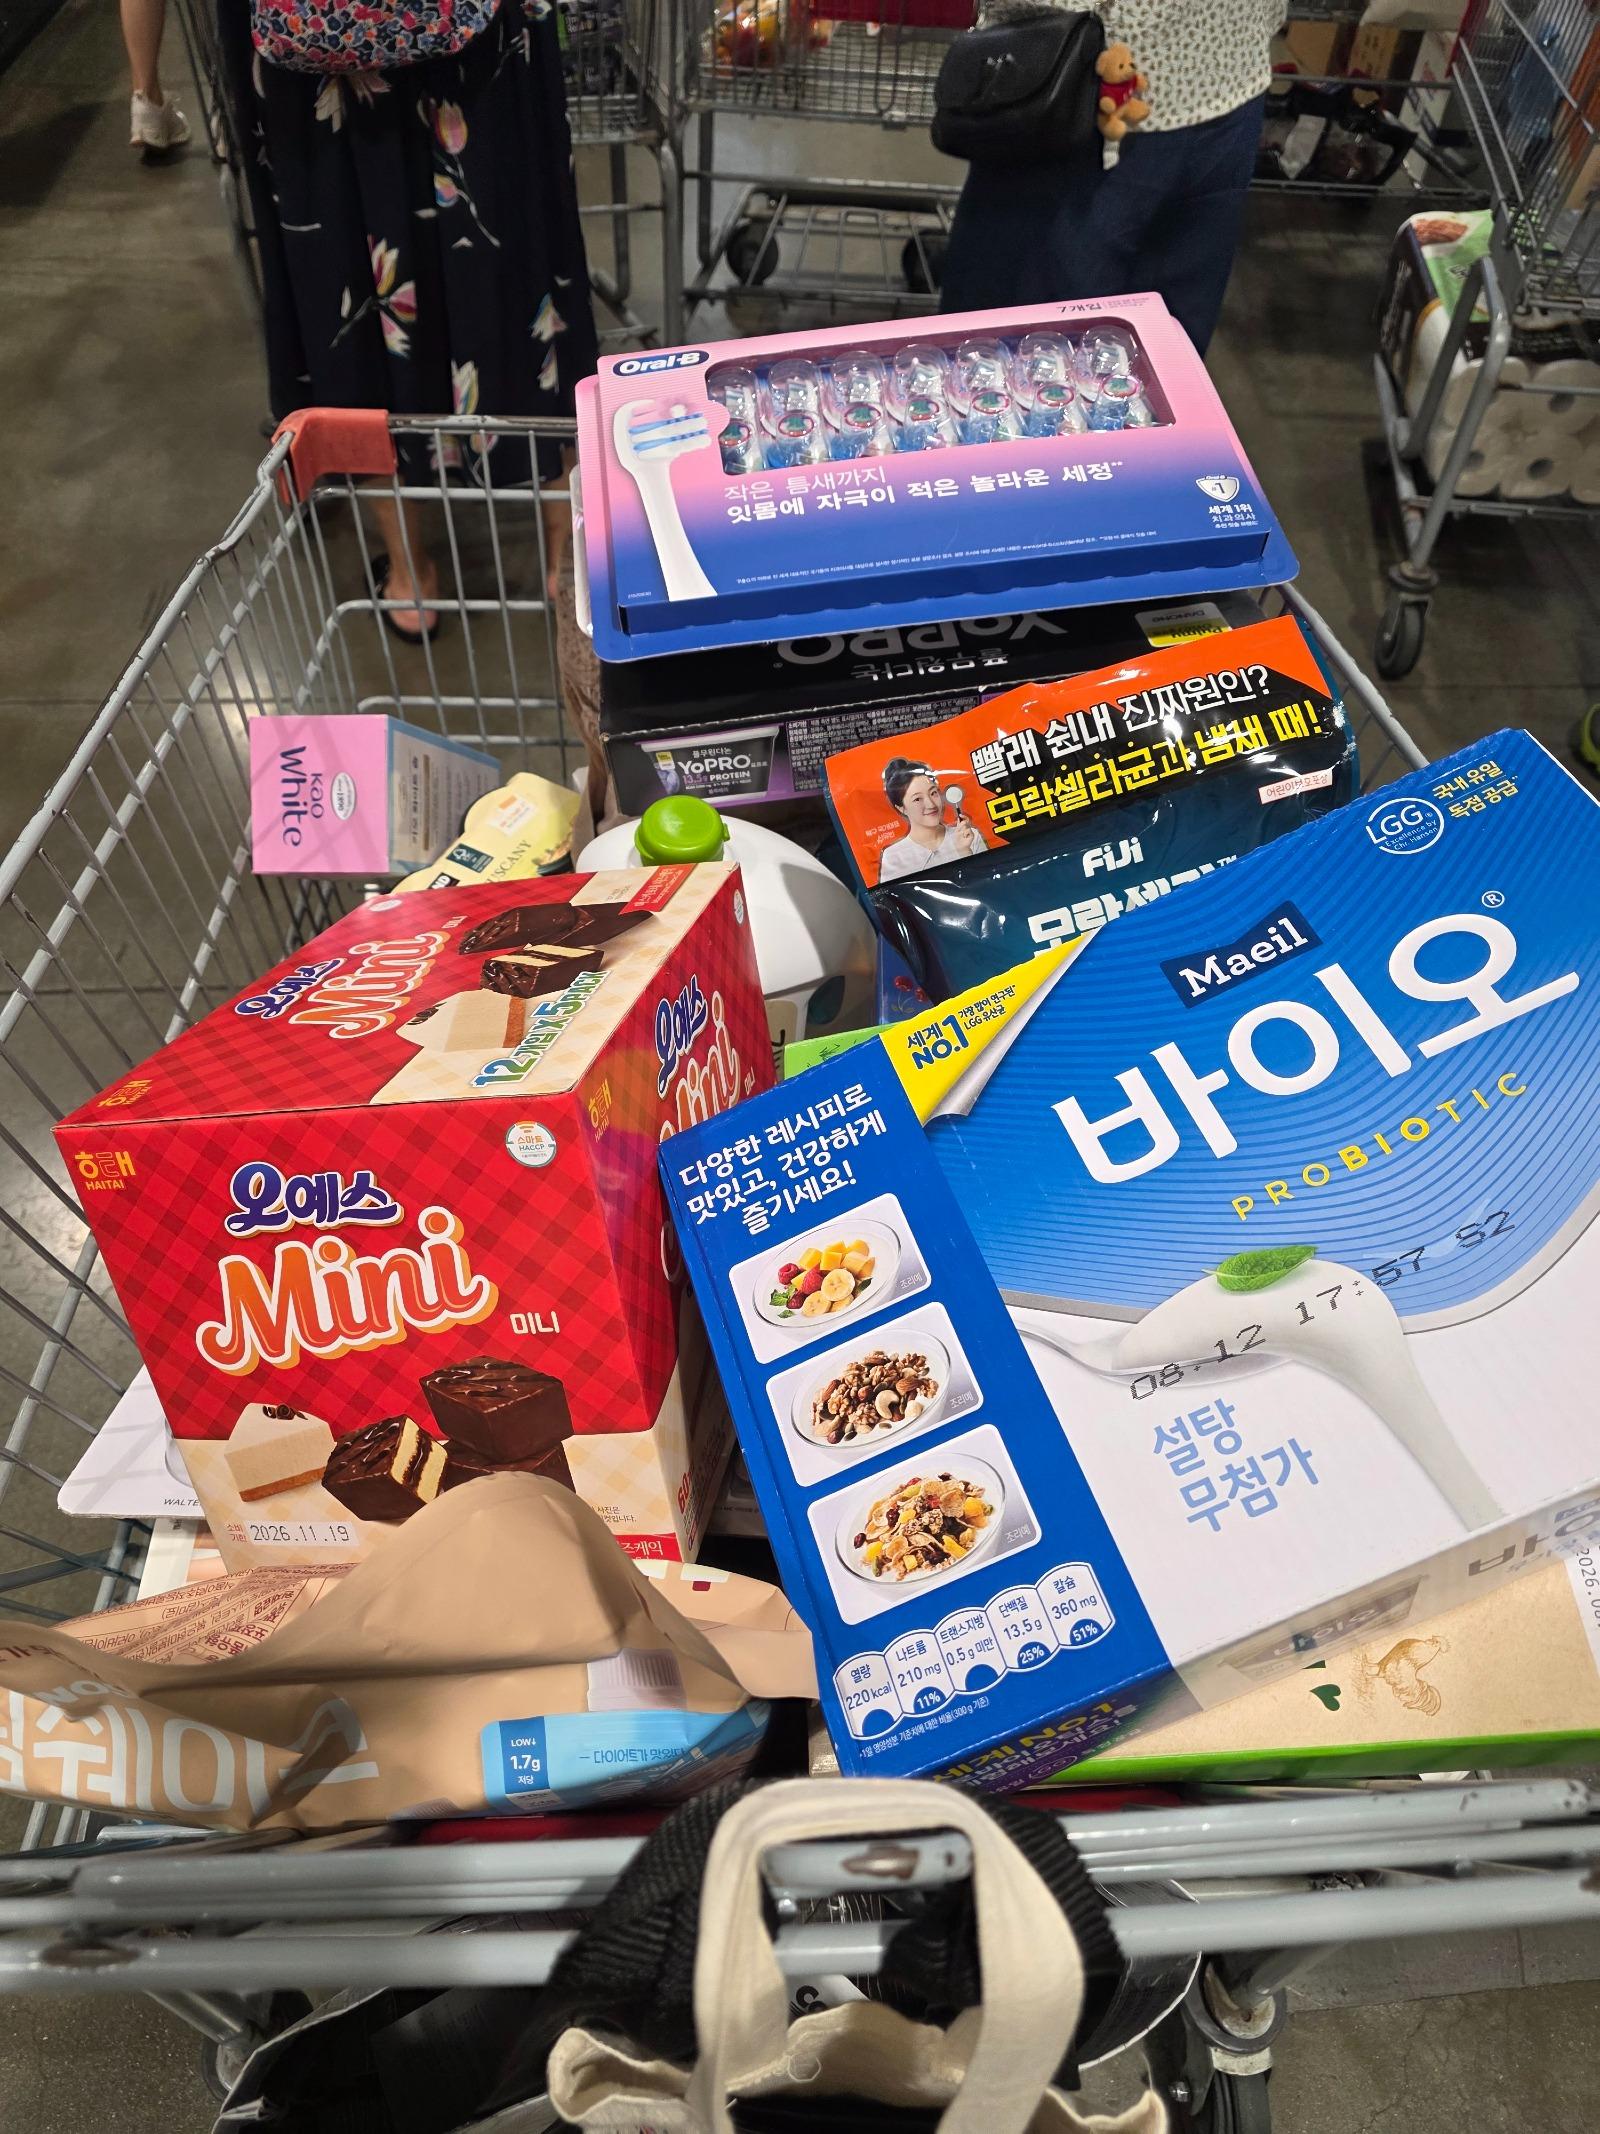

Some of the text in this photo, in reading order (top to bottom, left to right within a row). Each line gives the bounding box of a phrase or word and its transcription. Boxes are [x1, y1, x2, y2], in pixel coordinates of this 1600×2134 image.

[618, 352, 701, 375] Oral-B
[724, 466, 887, 503] 작은 틈새까지
[726, 498, 805, 524] 잇몸에
[817, 485, 896, 511] 자극이
[906, 477, 960, 500] 적은
[970, 468, 1050, 494] 놀라운
[971, 728, 1042, 785] 빨래
[1045, 702, 1117, 759] 쉰내
[677, 754, 751, 775] YoPRO
[709, 771, 751, 782] PROTEIN
[986, 699, 1323, 834] 모락셀라균과 냄새 때!
[1432, 760, 1504, 800] 국내 유일
[280, 746, 308, 848] White
[1448, 794, 1487, 819] 독점
[1366, 804, 1424, 845] LGG
[1384, 819, 1437, 848] Excellence by
[1409, 827, 1439, 846] Hansen
[1177, 915, 1309, 999] Maeil
[235, 957, 347, 1020] 오예스
[287, 931, 452, 1040] Mini
[958, 1005, 975, 1018] 가장
[974, 997, 992, 1014] 많이
[963, 1005, 1007, 1031] LGG 유산균
[655, 974, 709, 1100] 오예스
[907, 1021, 943, 1049] 세계
[1050, 911, 1580, 1185] 바이오
[678, 1082, 873, 1187] 다양한 레시피로
[1230, 1071, 1528, 1223] PROBIOTIC
[686, 1109, 887, 1226] 맛있고, 건강하게
[85, 1180, 125, 1191] HAITAI
[741, 1158, 857, 1236] 즐기세요!
[224, 1161, 403, 1238] 오예스
[195, 1205, 499, 1376] Mini
[900, 1273, 923, 1289] 조리예
[511, 1311, 560, 1336] 미니
[1129, 1322, 1266, 1402] 08.12
[1294, 1246, 1426, 1326] 17:57
[950, 1390, 974, 1409] 조리예
[1152, 1397, 1244, 1478] 설탕
[1178, 1437, 1319, 1533] 무첨가
[226, 1523, 244, 1533] 소비
[230, 1533, 247, 1543] 기한
[250, 1524, 350, 1543] 2026.11.19
[1053, 1574, 1077, 1594] 칼슘
[998, 1595, 1029, 1618] 단백질
[1051, 1594, 1098, 1620] 360 mg
[939, 1614, 985, 1645] 트랜스지방
[1002, 1618, 1034, 1641] 13.5
[1072, 1622, 1098, 1642] 51%
[895, 1639, 928, 1663] 나트륨
[946, 1648, 967, 1667] 0.5
[974, 1636, 996, 1654] 미만
[1019, 1645, 1045, 1664] 25%
[850, 1663, 871, 1683] 열량
[897, 1661, 942, 1688] 210 mg
[844, 1681, 893, 1712] 220 kcal
[915, 1690, 941, 1709] 11%
[923, 1715, 940, 1732] 대한
[510, 1755, 541, 1772] 1.7g
[594, 1749, 648, 1764] 다이어트가
[518, 1775, 534, 1785] 저당
